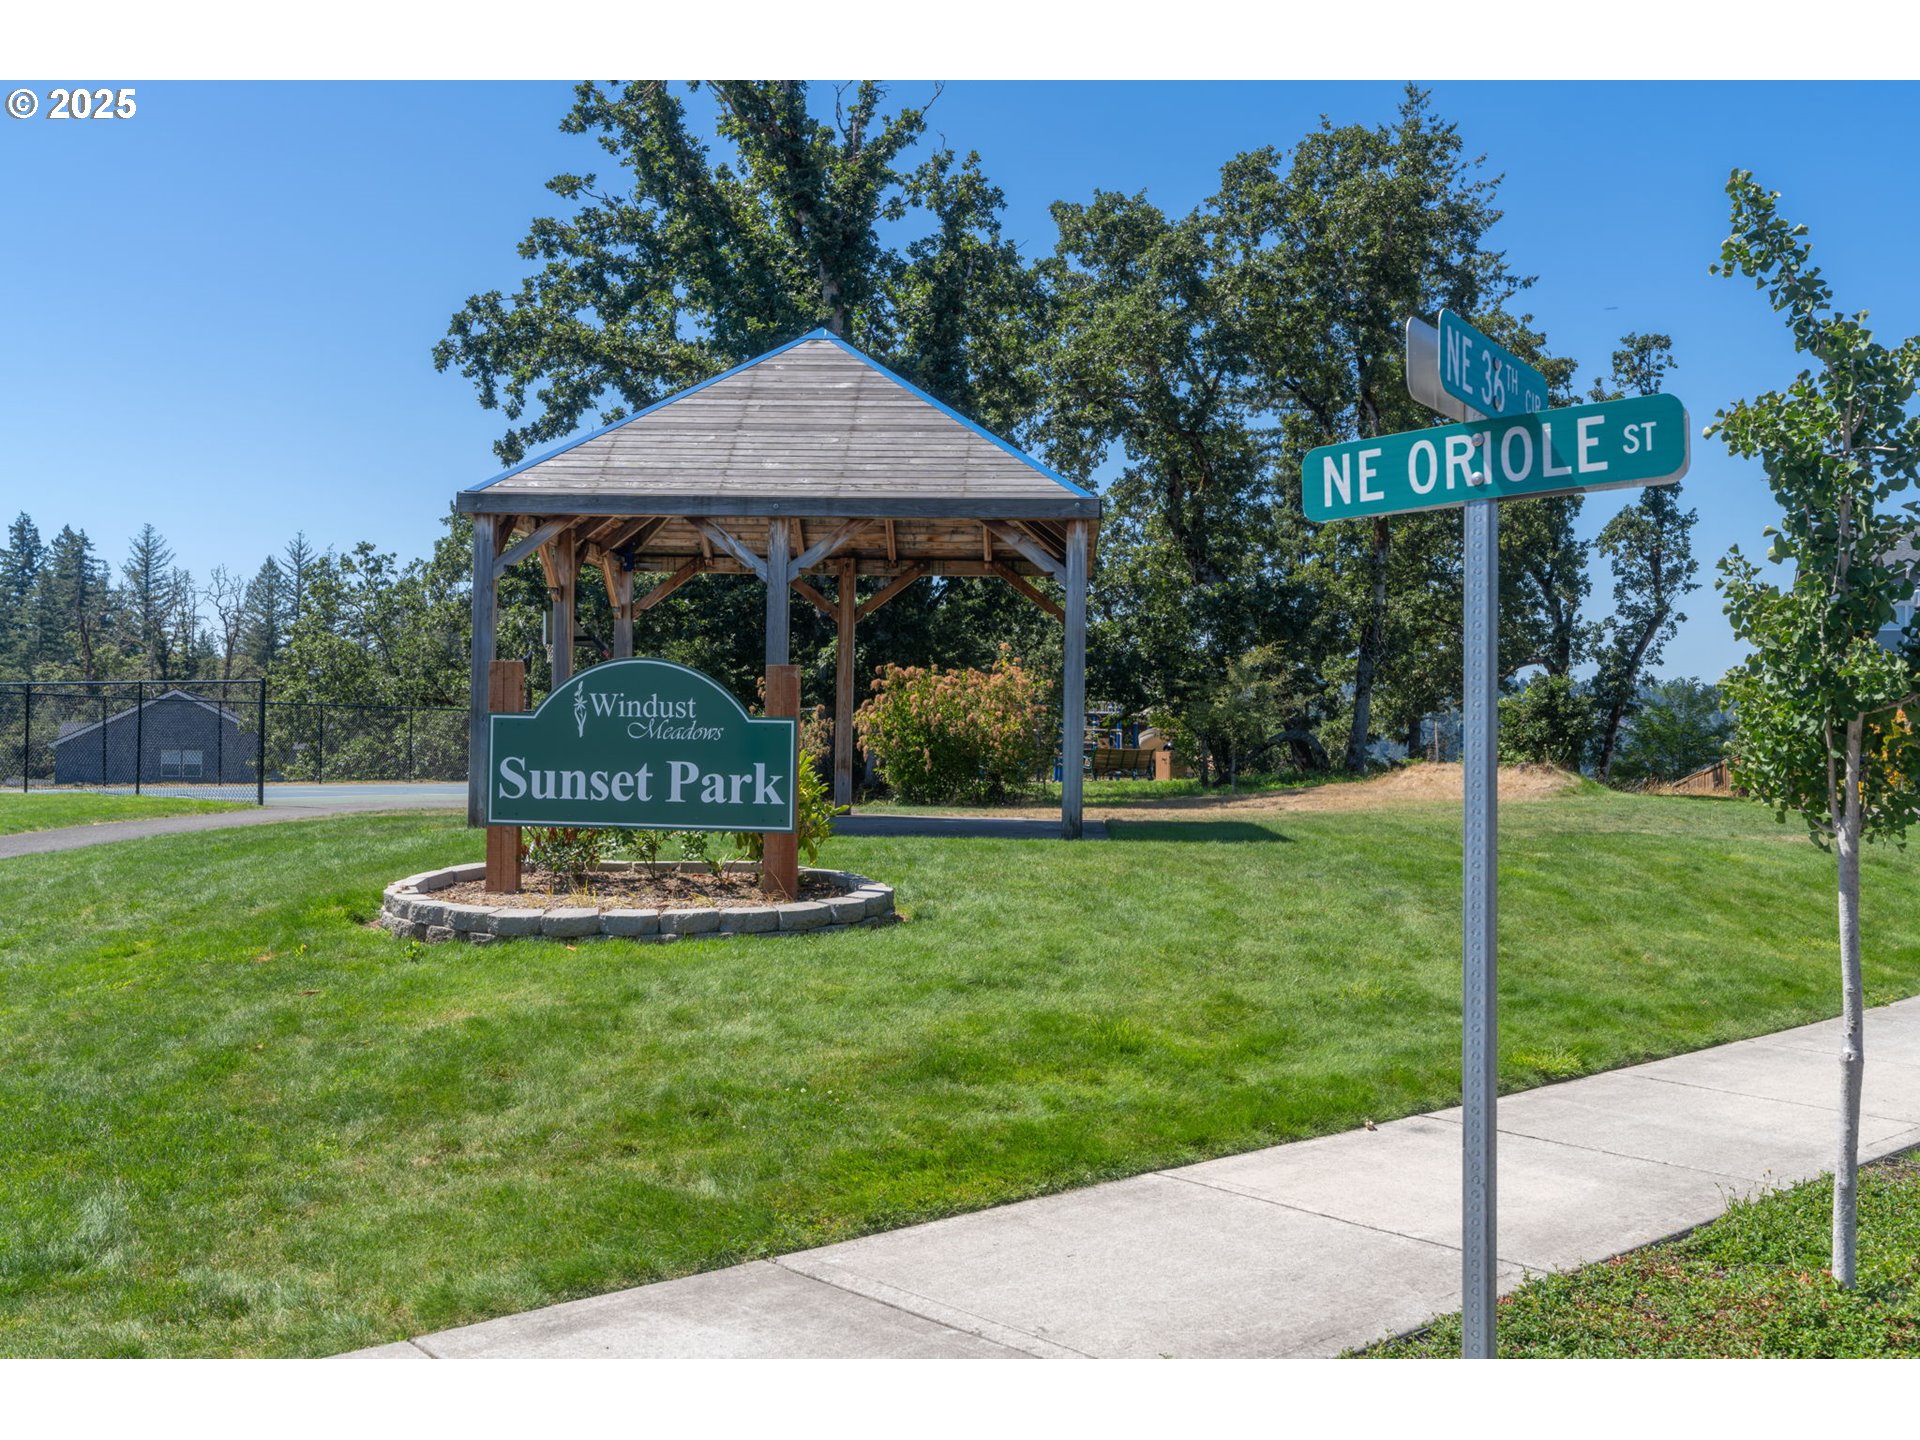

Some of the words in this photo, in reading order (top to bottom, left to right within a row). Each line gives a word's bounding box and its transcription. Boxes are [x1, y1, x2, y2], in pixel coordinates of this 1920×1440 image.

[1446, 325, 1473, 395] NE
[1525, 389, 1542, 414] CIR
[1323, 447, 1385, 508] NE
[1407, 414, 1609, 495] ORIOLE
[1622, 420, 1658, 454] ST
[589, 692, 697, 718] Windust
[627, 718, 724, 741] Meadows
[499, 756, 653, 802] Sunset
[665, 760, 785, 806] Park
